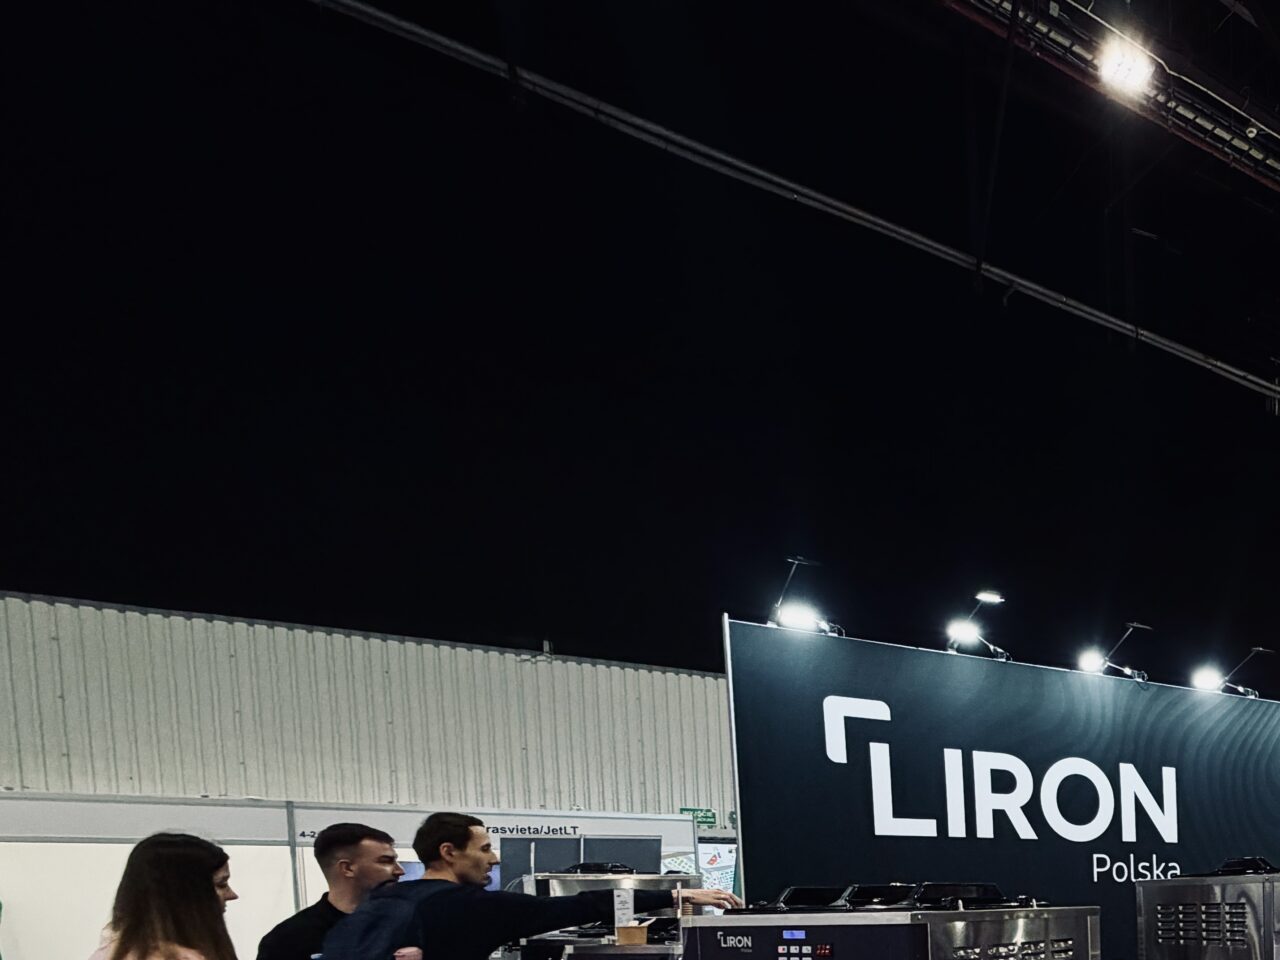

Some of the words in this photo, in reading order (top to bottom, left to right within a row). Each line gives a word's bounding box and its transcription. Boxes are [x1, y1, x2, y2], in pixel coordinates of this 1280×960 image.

[869, 742, 1178, 843] LIRON
[1092, 854, 1181, 882] Polska
[720, 935, 752, 948] LIRON
